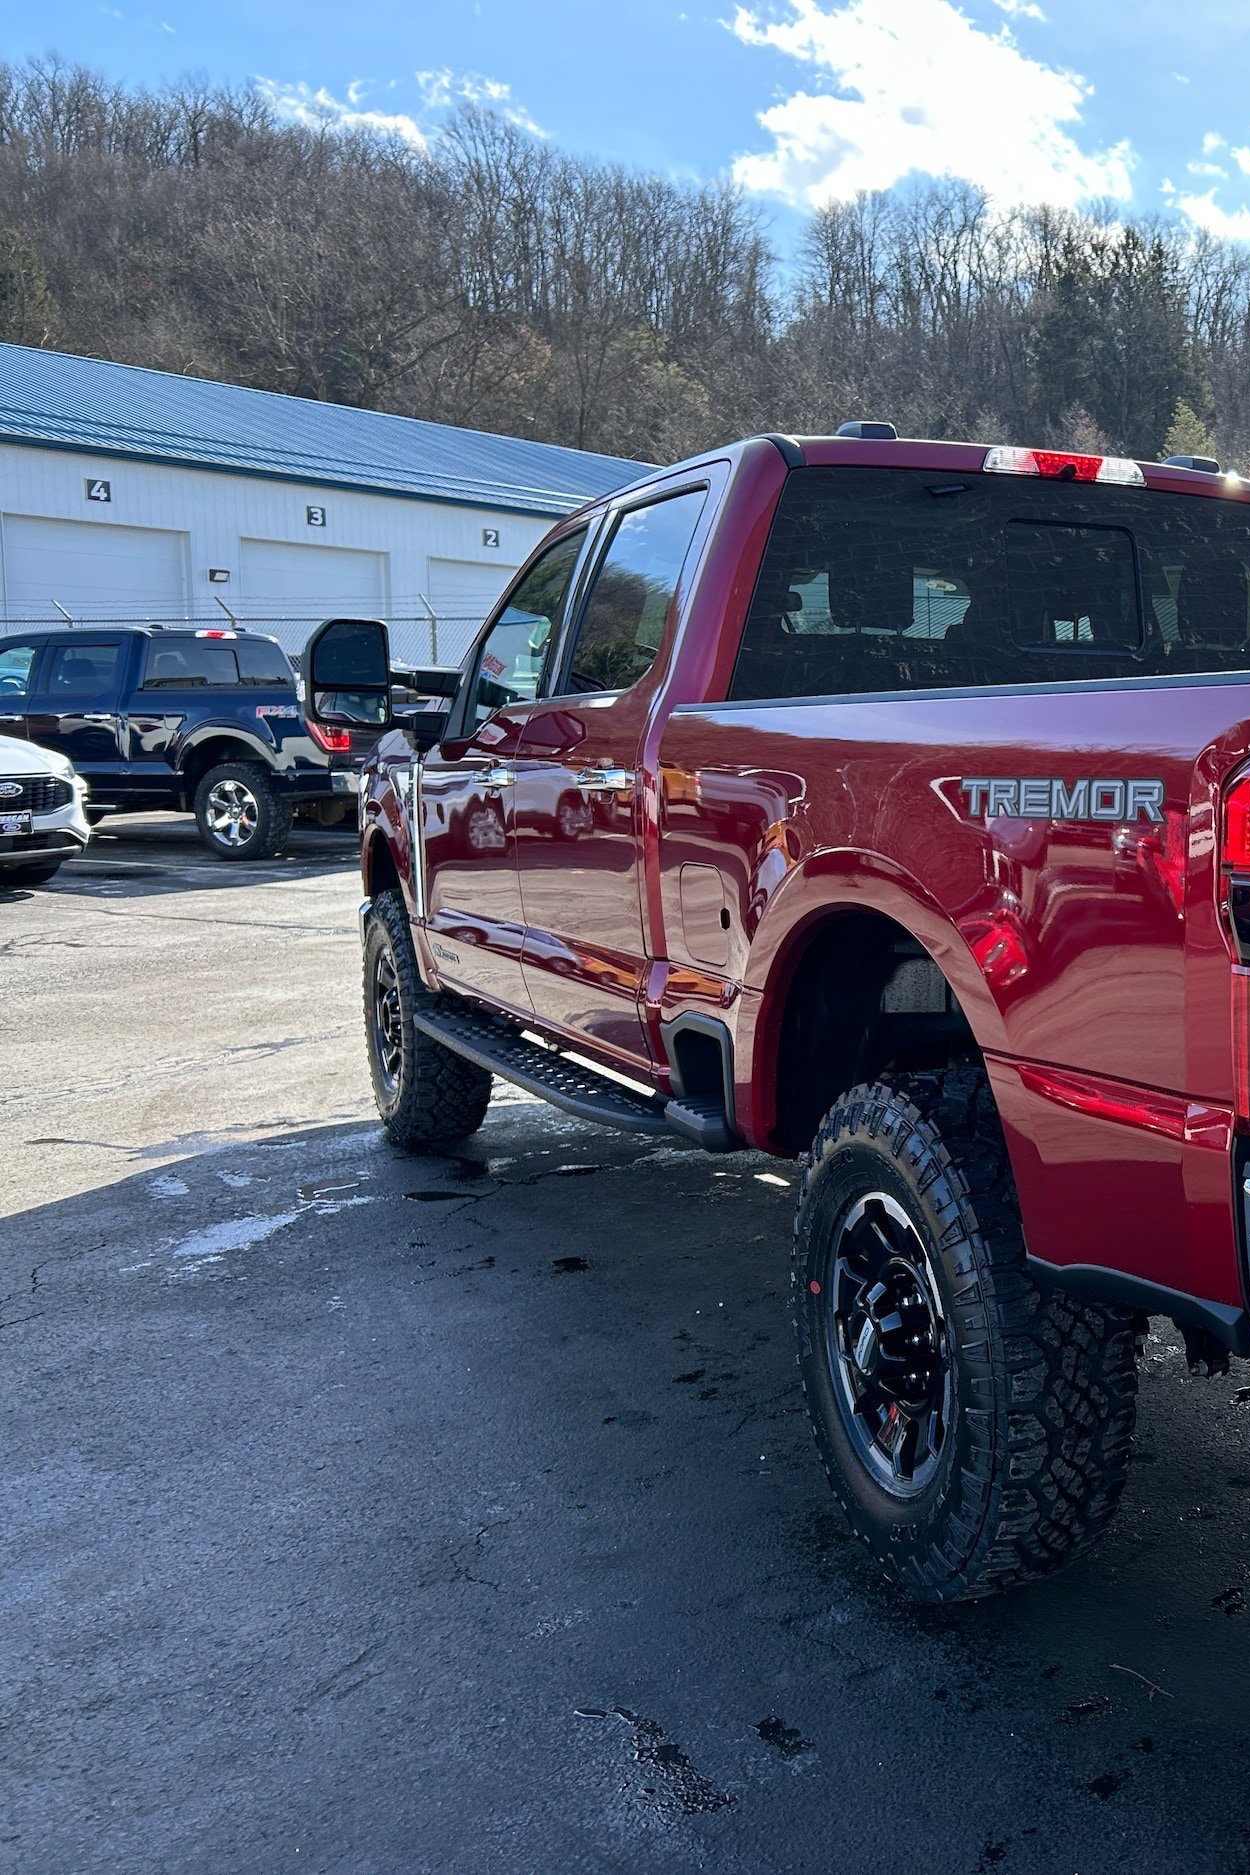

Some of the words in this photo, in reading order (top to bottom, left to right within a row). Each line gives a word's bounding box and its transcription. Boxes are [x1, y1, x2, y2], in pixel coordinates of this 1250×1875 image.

[90, 481, 107, 500] 4
[310, 508, 323, 525] 3
[486, 531, 497, 546] 2
[256, 705, 298, 718] FX4
[961, 776, 1166, 823] TREMOR
